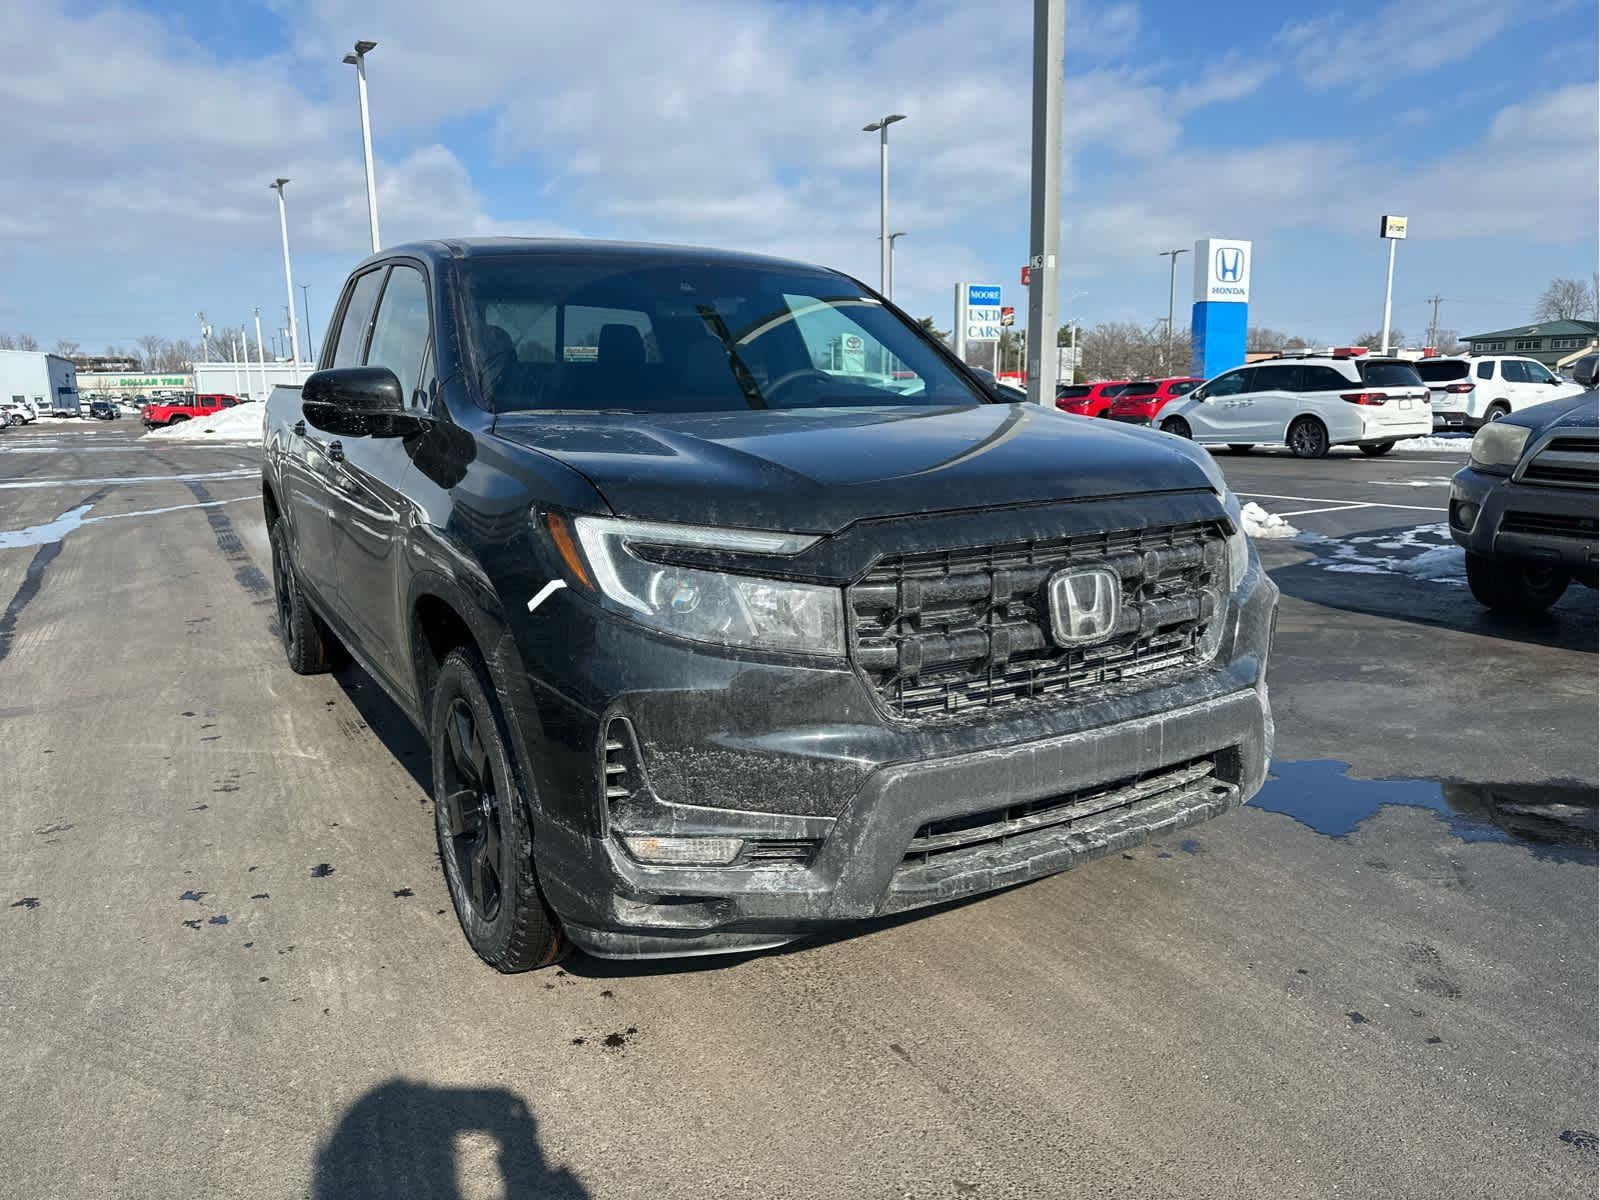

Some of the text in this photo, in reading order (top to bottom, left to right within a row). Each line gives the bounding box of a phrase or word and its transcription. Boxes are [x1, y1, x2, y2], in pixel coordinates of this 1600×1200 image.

[970, 290, 1000, 300] MOORE
[1211, 287, 1246, 295] HONDA
[969, 309, 1000, 321] USED
[968, 326, 1000, 338] CARS
[160, 378, 184, 386] TREE
